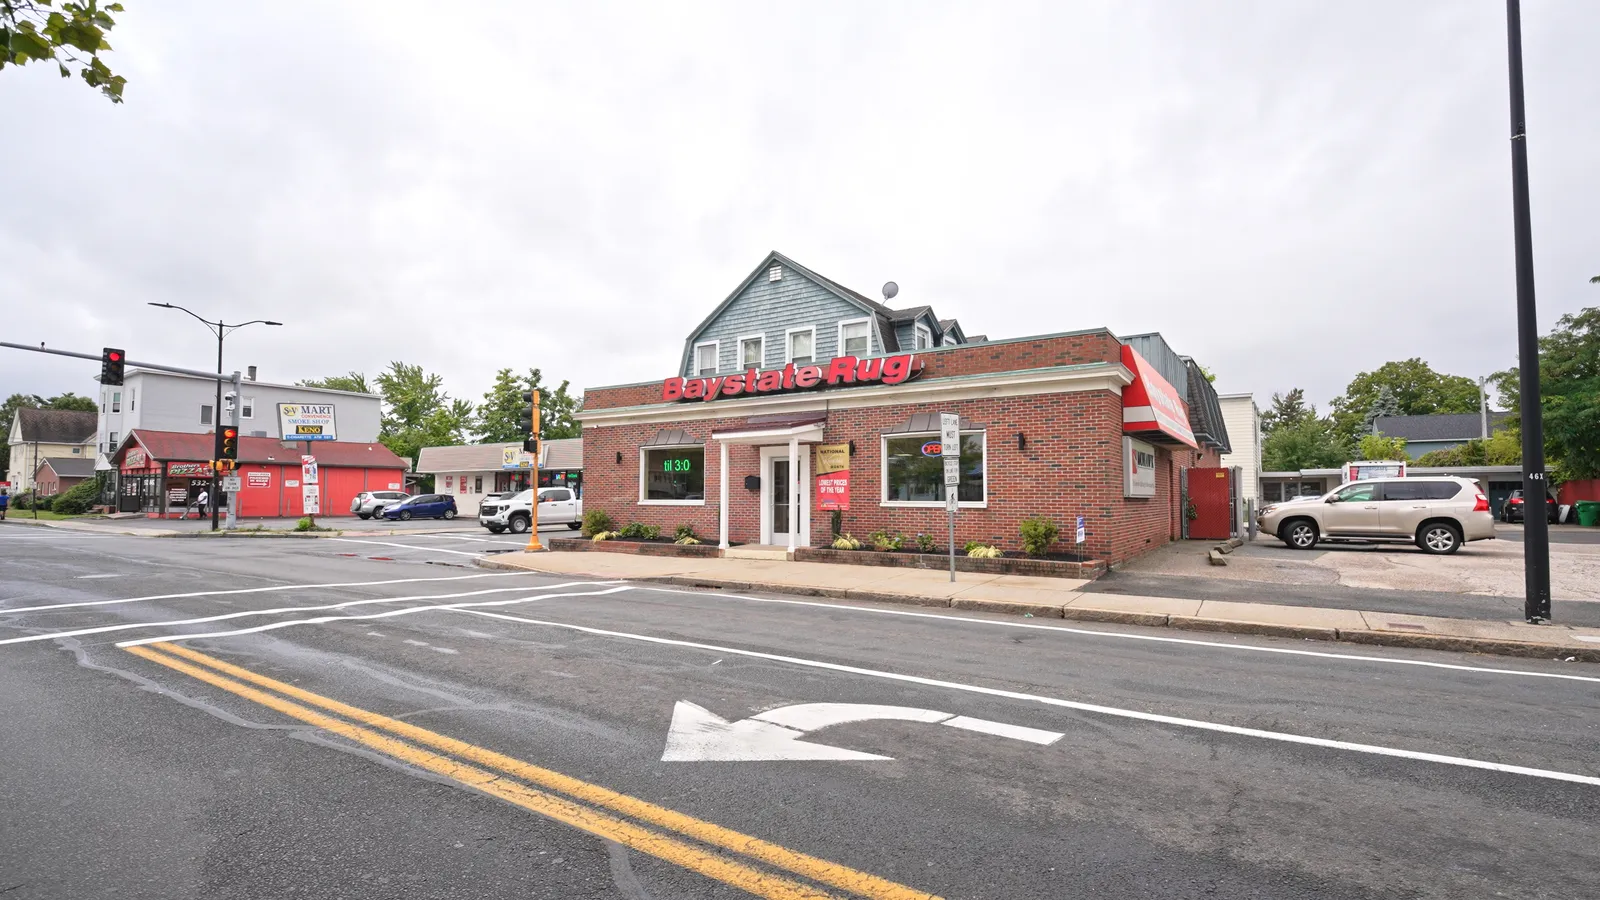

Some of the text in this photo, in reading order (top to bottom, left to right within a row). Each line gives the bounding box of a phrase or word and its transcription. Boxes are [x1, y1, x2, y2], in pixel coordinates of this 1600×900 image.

[662, 354, 914, 400] Baystate Rug
[301, 406, 332, 414] MART
[297, 426, 321, 434] KENO
[946, 430, 956, 439] MUST
[664, 459, 672, 472] til
[169, 467, 203, 475] PIZZA
[820, 486, 845, 494] OF THE YEAR
